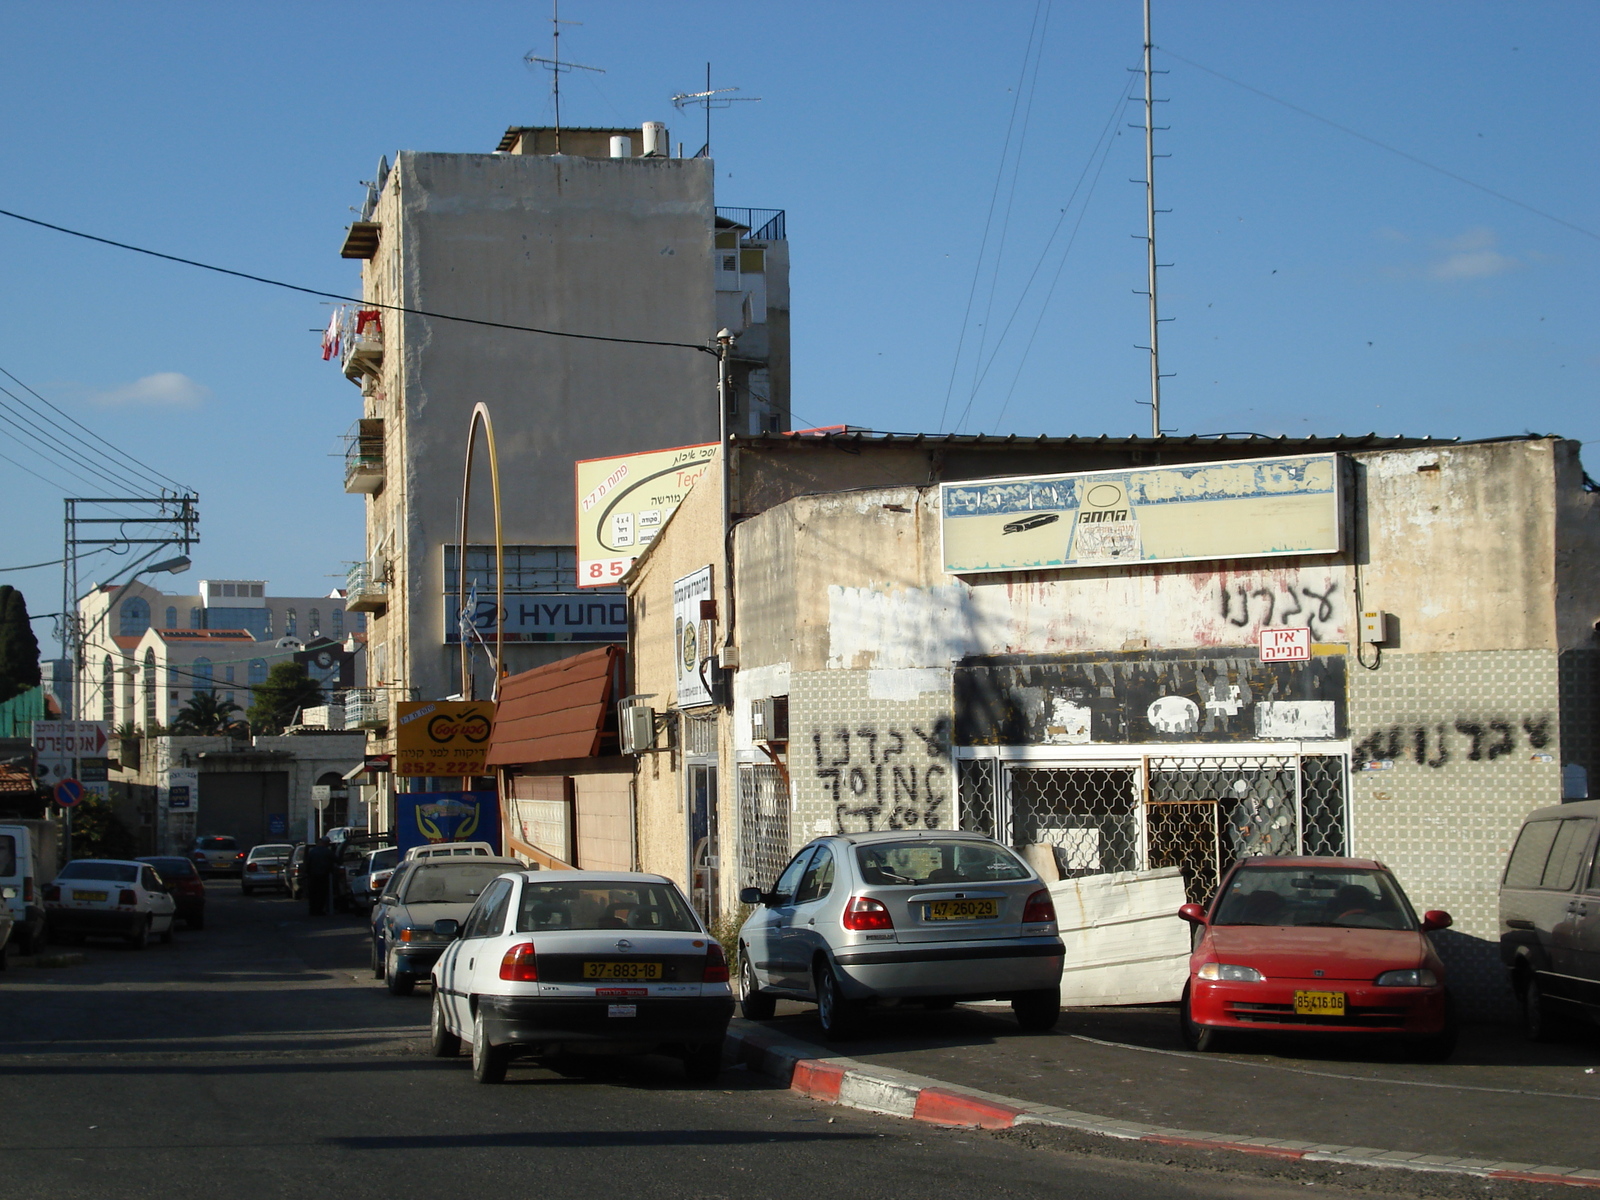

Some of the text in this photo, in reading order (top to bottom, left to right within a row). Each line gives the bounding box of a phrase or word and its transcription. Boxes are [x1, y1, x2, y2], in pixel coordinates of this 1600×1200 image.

[607, 464, 628, 488] פתוח
[650, 494, 681, 506] מורשה
[1078, 509, 1128, 524] FIAT
[1274, 632, 1295, 646] אין
[1266, 646, 1304, 658] חנייה
[401, 747, 488, 760] דיקות לפני קניה
[589, 963, 657, 977] 37-883-18
